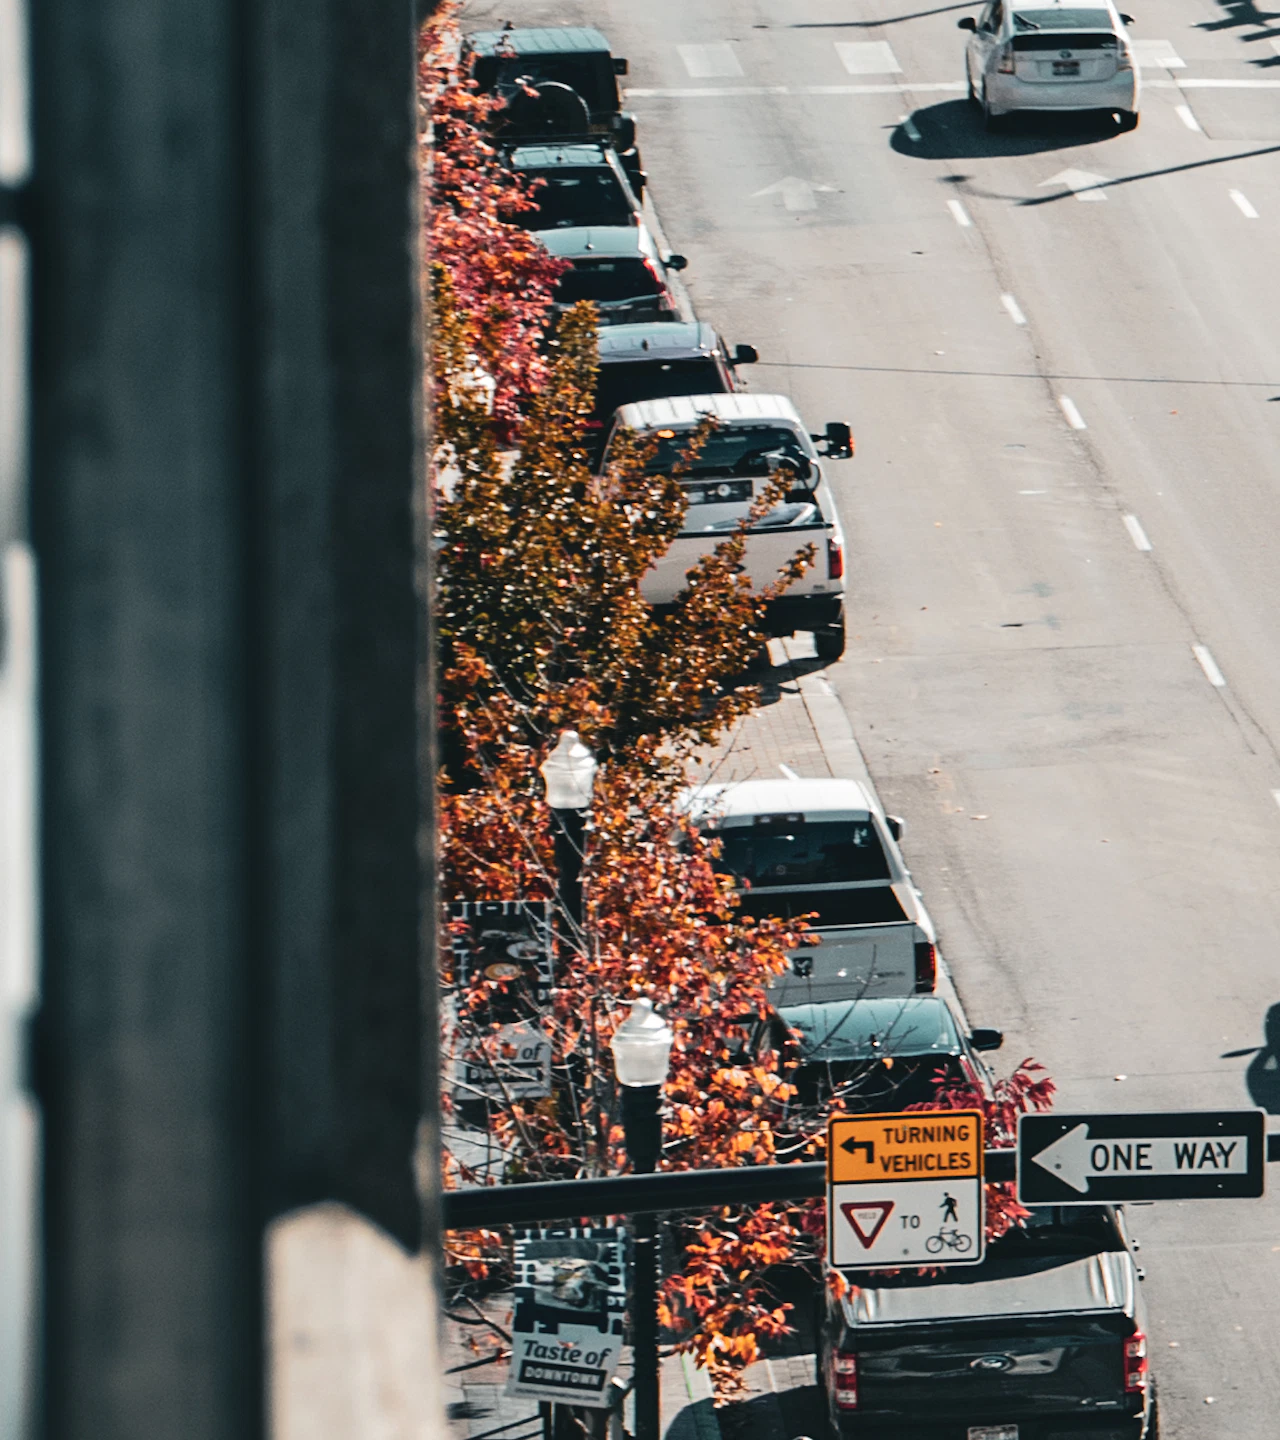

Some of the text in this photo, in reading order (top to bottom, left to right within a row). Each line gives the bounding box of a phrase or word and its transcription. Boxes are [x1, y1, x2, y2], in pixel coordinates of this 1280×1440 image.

[521, 1042, 543, 1060] of
[883, 1125, 970, 1144] TURNING
[880, 1152, 972, 1172] VEHICLES
[1090, 1141, 1238, 1171] ONE WAY
[900, 1215, 921, 1229] TO
[523, 1339, 612, 1368] Taste of
[525, 1366, 600, 1386] DOWNTOWN
